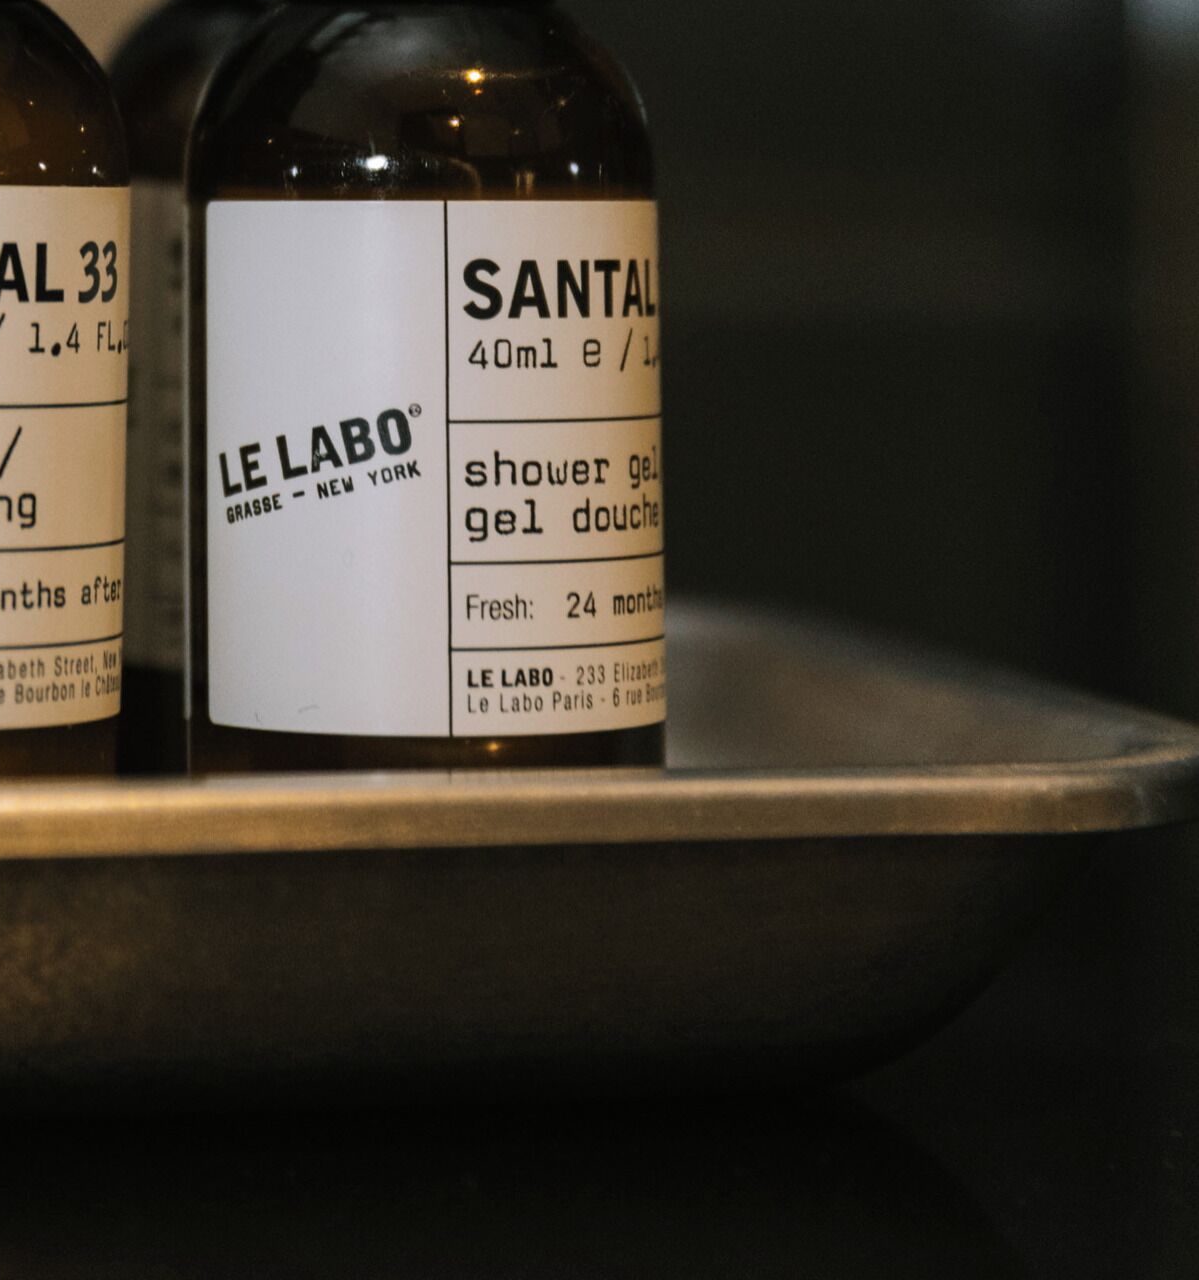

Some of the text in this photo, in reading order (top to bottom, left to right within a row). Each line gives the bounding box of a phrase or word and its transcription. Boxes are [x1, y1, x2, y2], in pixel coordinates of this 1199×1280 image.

[78, 240, 117, 303] 33
[463, 258, 656, 320] SANTAL
[29, 322, 80, 357] 1.4
[468, 338, 558, 370] 40ml
[219, 443, 268, 497] LE
[465, 451, 609, 486] shower
[226, 494, 283, 524] GRASSE
[317, 476, 355, 499] NEW
[367, 460, 421, 487] YORK
[465, 493, 659, 542] gel douche
[81, 576, 121, 605] after
[466, 593, 533, 620] Fresh:
[566, 591, 596, 618] 24
[54, 654, 98, 677] Street,
[467, 669, 494, 688] LE
[502, 667, 554, 688] LABO
[576, 664, 606, 686] 233
[15, 682, 75, 704] Bourbon
[467, 693, 489, 714] Le
[500, 692, 543, 713] Labo
[553, 690, 593, 712] Paris
[613, 687, 620, 707] 6
[626, 688, 642, 705] rue
